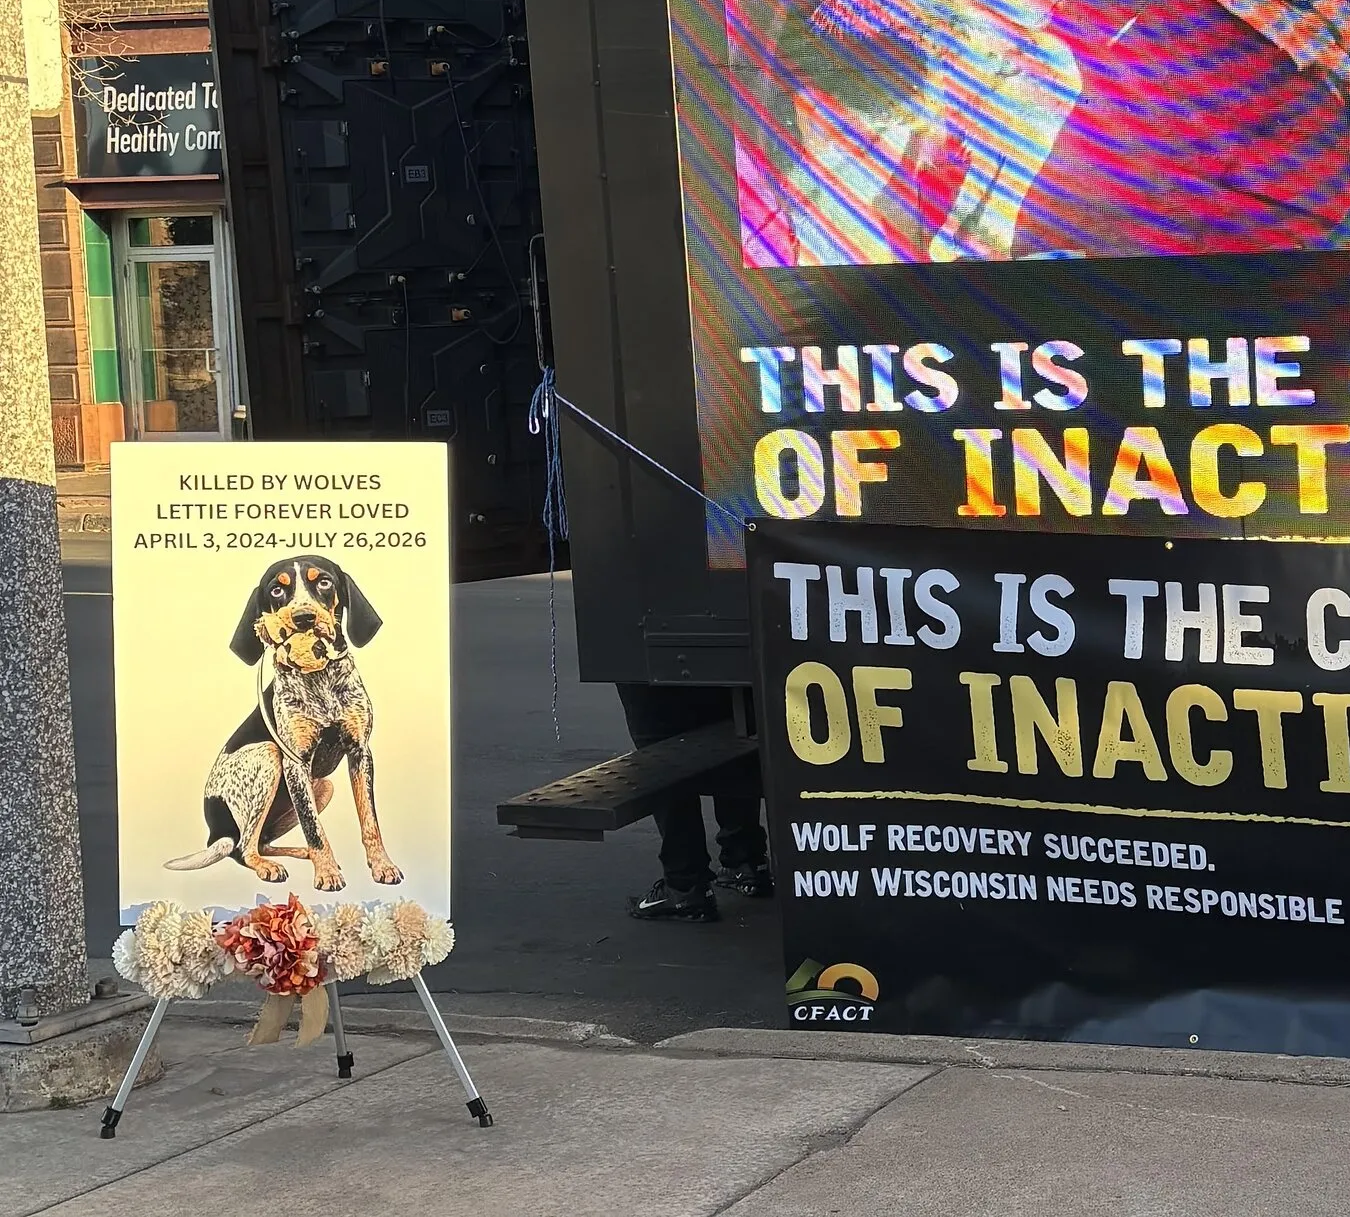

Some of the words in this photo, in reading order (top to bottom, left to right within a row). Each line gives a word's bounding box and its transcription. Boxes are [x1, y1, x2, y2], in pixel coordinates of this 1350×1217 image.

[103, 82, 197, 112] Dedicated
[106, 124, 180, 156] Healthy
[741, 341, 960, 413] THIS
[990, 339, 1089, 412] IS
[1121, 336, 1316, 408] THE
[179, 474, 255, 491] KILLED
[261, 474, 288, 491] BY
[293, 474, 382, 491] WOLVES
[753, 427, 902, 518] OF
[156, 503, 228, 520] LETTIE
[234, 503, 332, 520] FOREVER
[339, 503, 410, 520] LOVED
[133, 532, 198, 549] APRIL
[203, 532, 221, 552] 3,
[226, 532, 338, 549] 2024-JULY
[343, 531, 427, 551] 26,2026
[773, 562, 961, 650] THIS
[992, 572, 1076, 657] IS
[1108, 578, 1275, 666] THE
[785, 661, 913, 766] OF
[790, 822, 877, 852] WOLF
[887, 824, 1032, 857] RECOVERY
[1043, 833, 1216, 871] SUCCEEDED.
[793, 870, 860, 897] NOW
[870, 867, 1038, 901] WISCONSIN
[1046, 875, 1137, 908] NEEDS
[1146, 884, 1345, 925] RESPONSIBLE
[793, 1005, 874, 1021] CFACT
